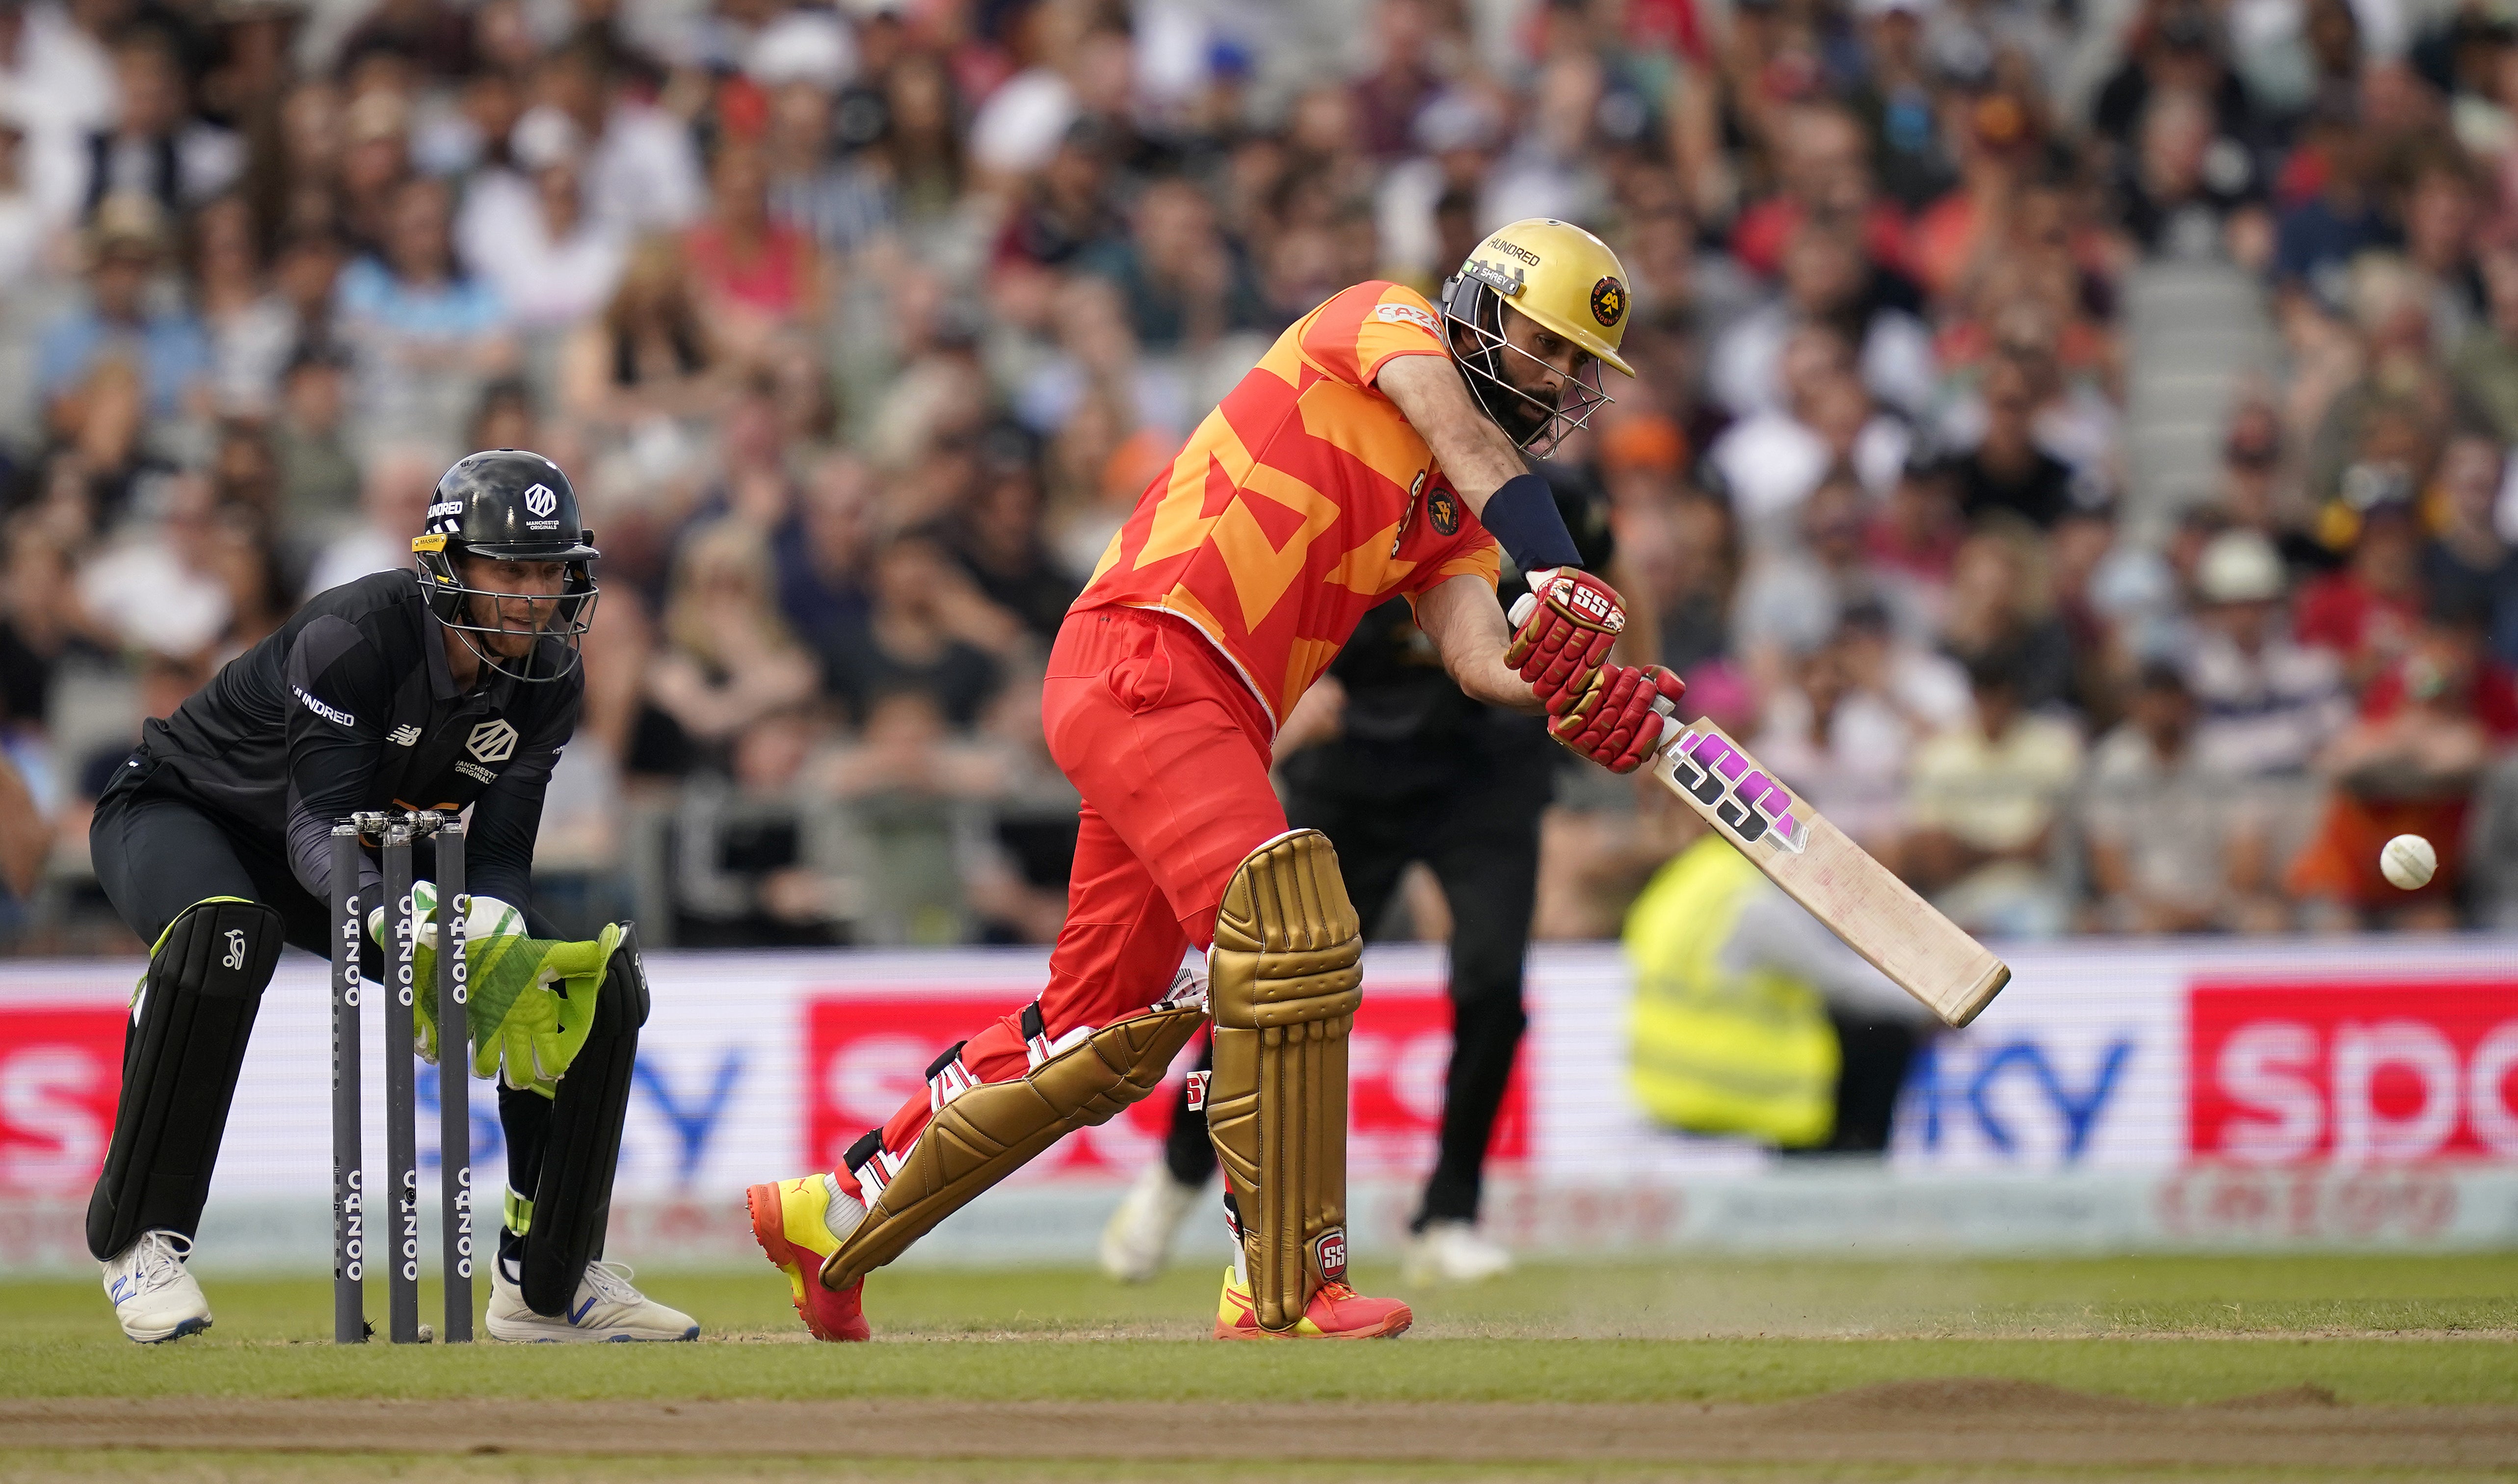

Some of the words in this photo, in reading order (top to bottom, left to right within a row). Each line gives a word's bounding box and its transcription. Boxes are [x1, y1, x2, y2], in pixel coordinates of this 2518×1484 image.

[1487, 238, 1540, 266] HUNDRED
[1481, 267, 1509, 286] SHREY
[1378, 307, 1447, 345] CAZO
[1572, 586, 1609, 618] SS
[455, 761, 498, 779] ANCHESTE
[455, 766, 494, 784] ORIGINAL
[1671, 733, 1793, 843] SS
[342, 896, 360, 1007] CAZOO
[395, 896, 413, 1007] CAZOO
[449, 893, 467, 1004] CAZOO
[344, 1170, 362, 1281] CAZOO
[454, 1167, 472, 1278] CAZOO
[1324, 1244, 1345, 1269] SS
